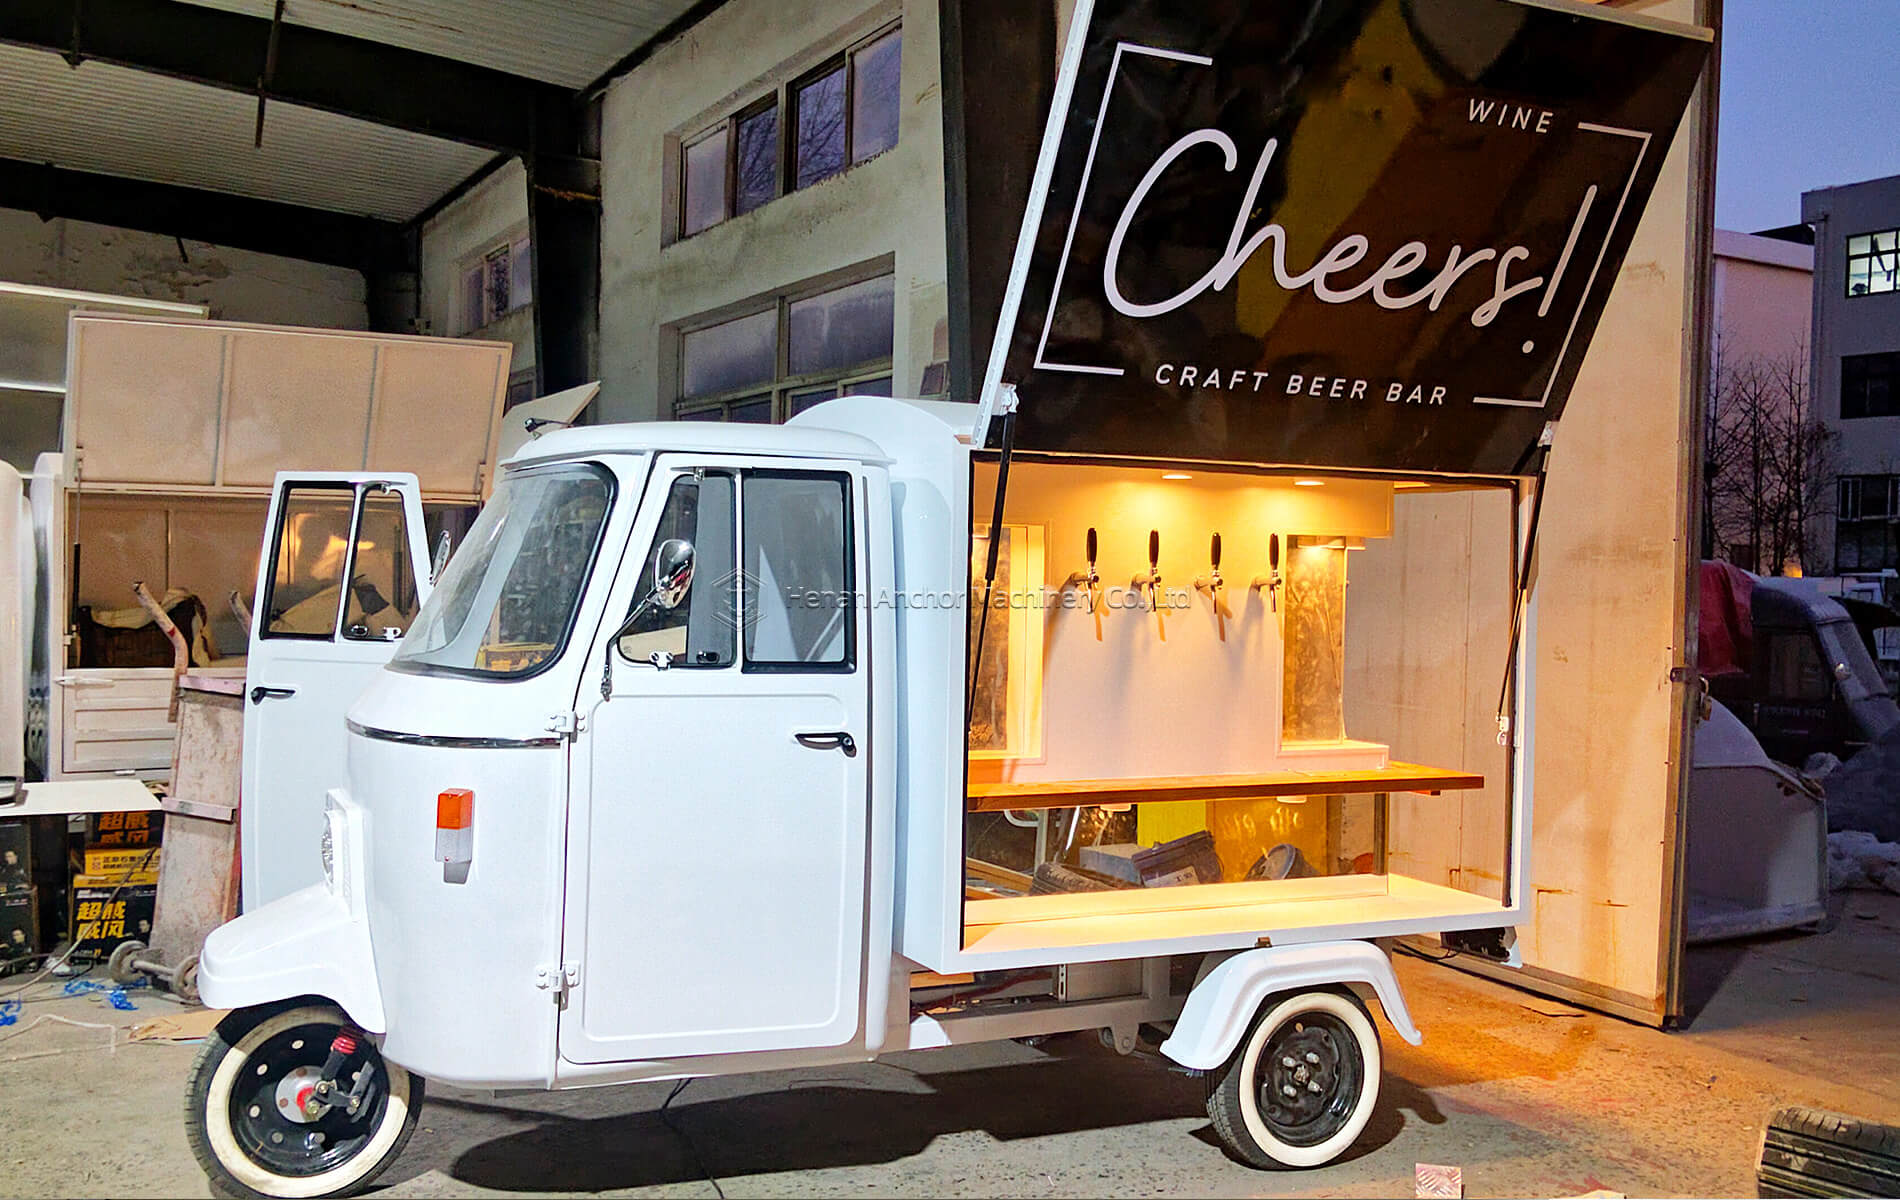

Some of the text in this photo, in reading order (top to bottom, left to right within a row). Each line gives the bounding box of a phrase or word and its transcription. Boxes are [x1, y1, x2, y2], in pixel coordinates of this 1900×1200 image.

[1470, 99, 1553, 132] WINE
[1103, 128, 1597, 354] Cheers!
[1156, 364, 1445, 404] CRAFT BEER BAR
